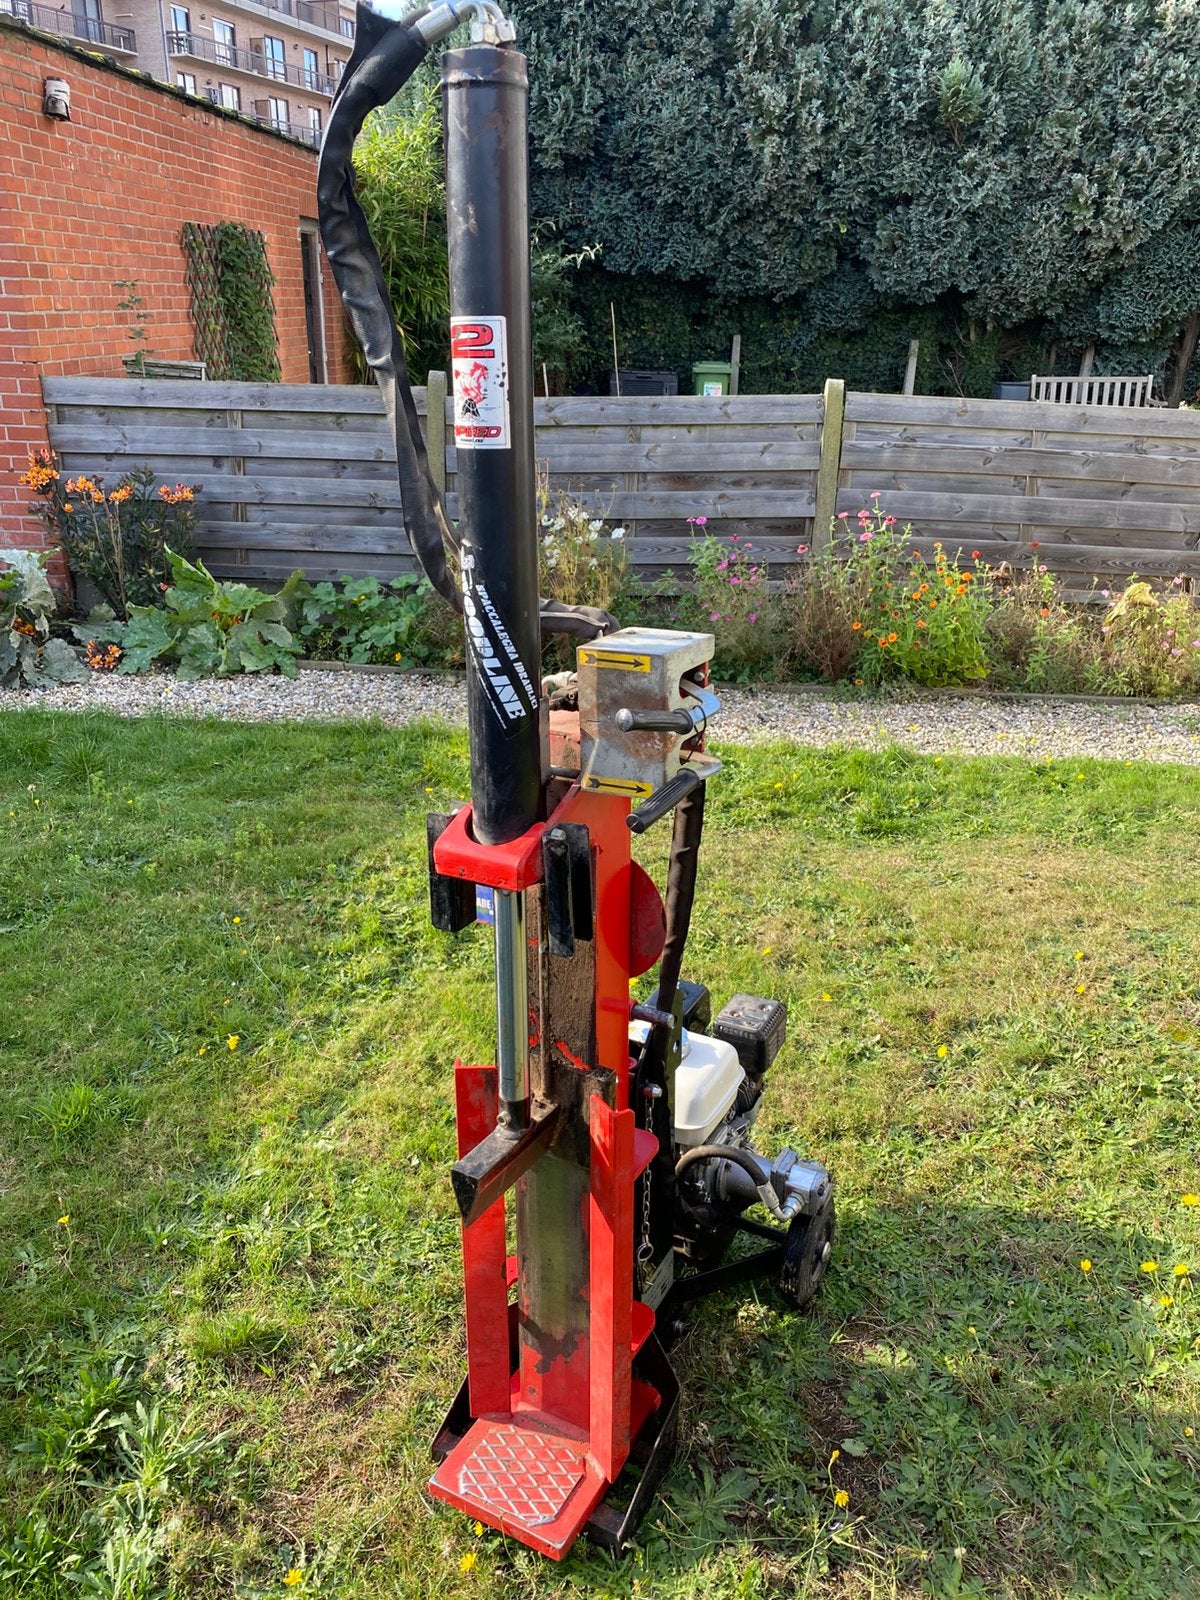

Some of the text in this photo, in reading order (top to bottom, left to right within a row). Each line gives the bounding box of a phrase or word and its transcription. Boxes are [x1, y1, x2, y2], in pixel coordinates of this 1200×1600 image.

[451, 324, 495, 358] 2
[455, 426, 502, 438] PEED
[476, 584, 520, 661] SPACCALEGNA
